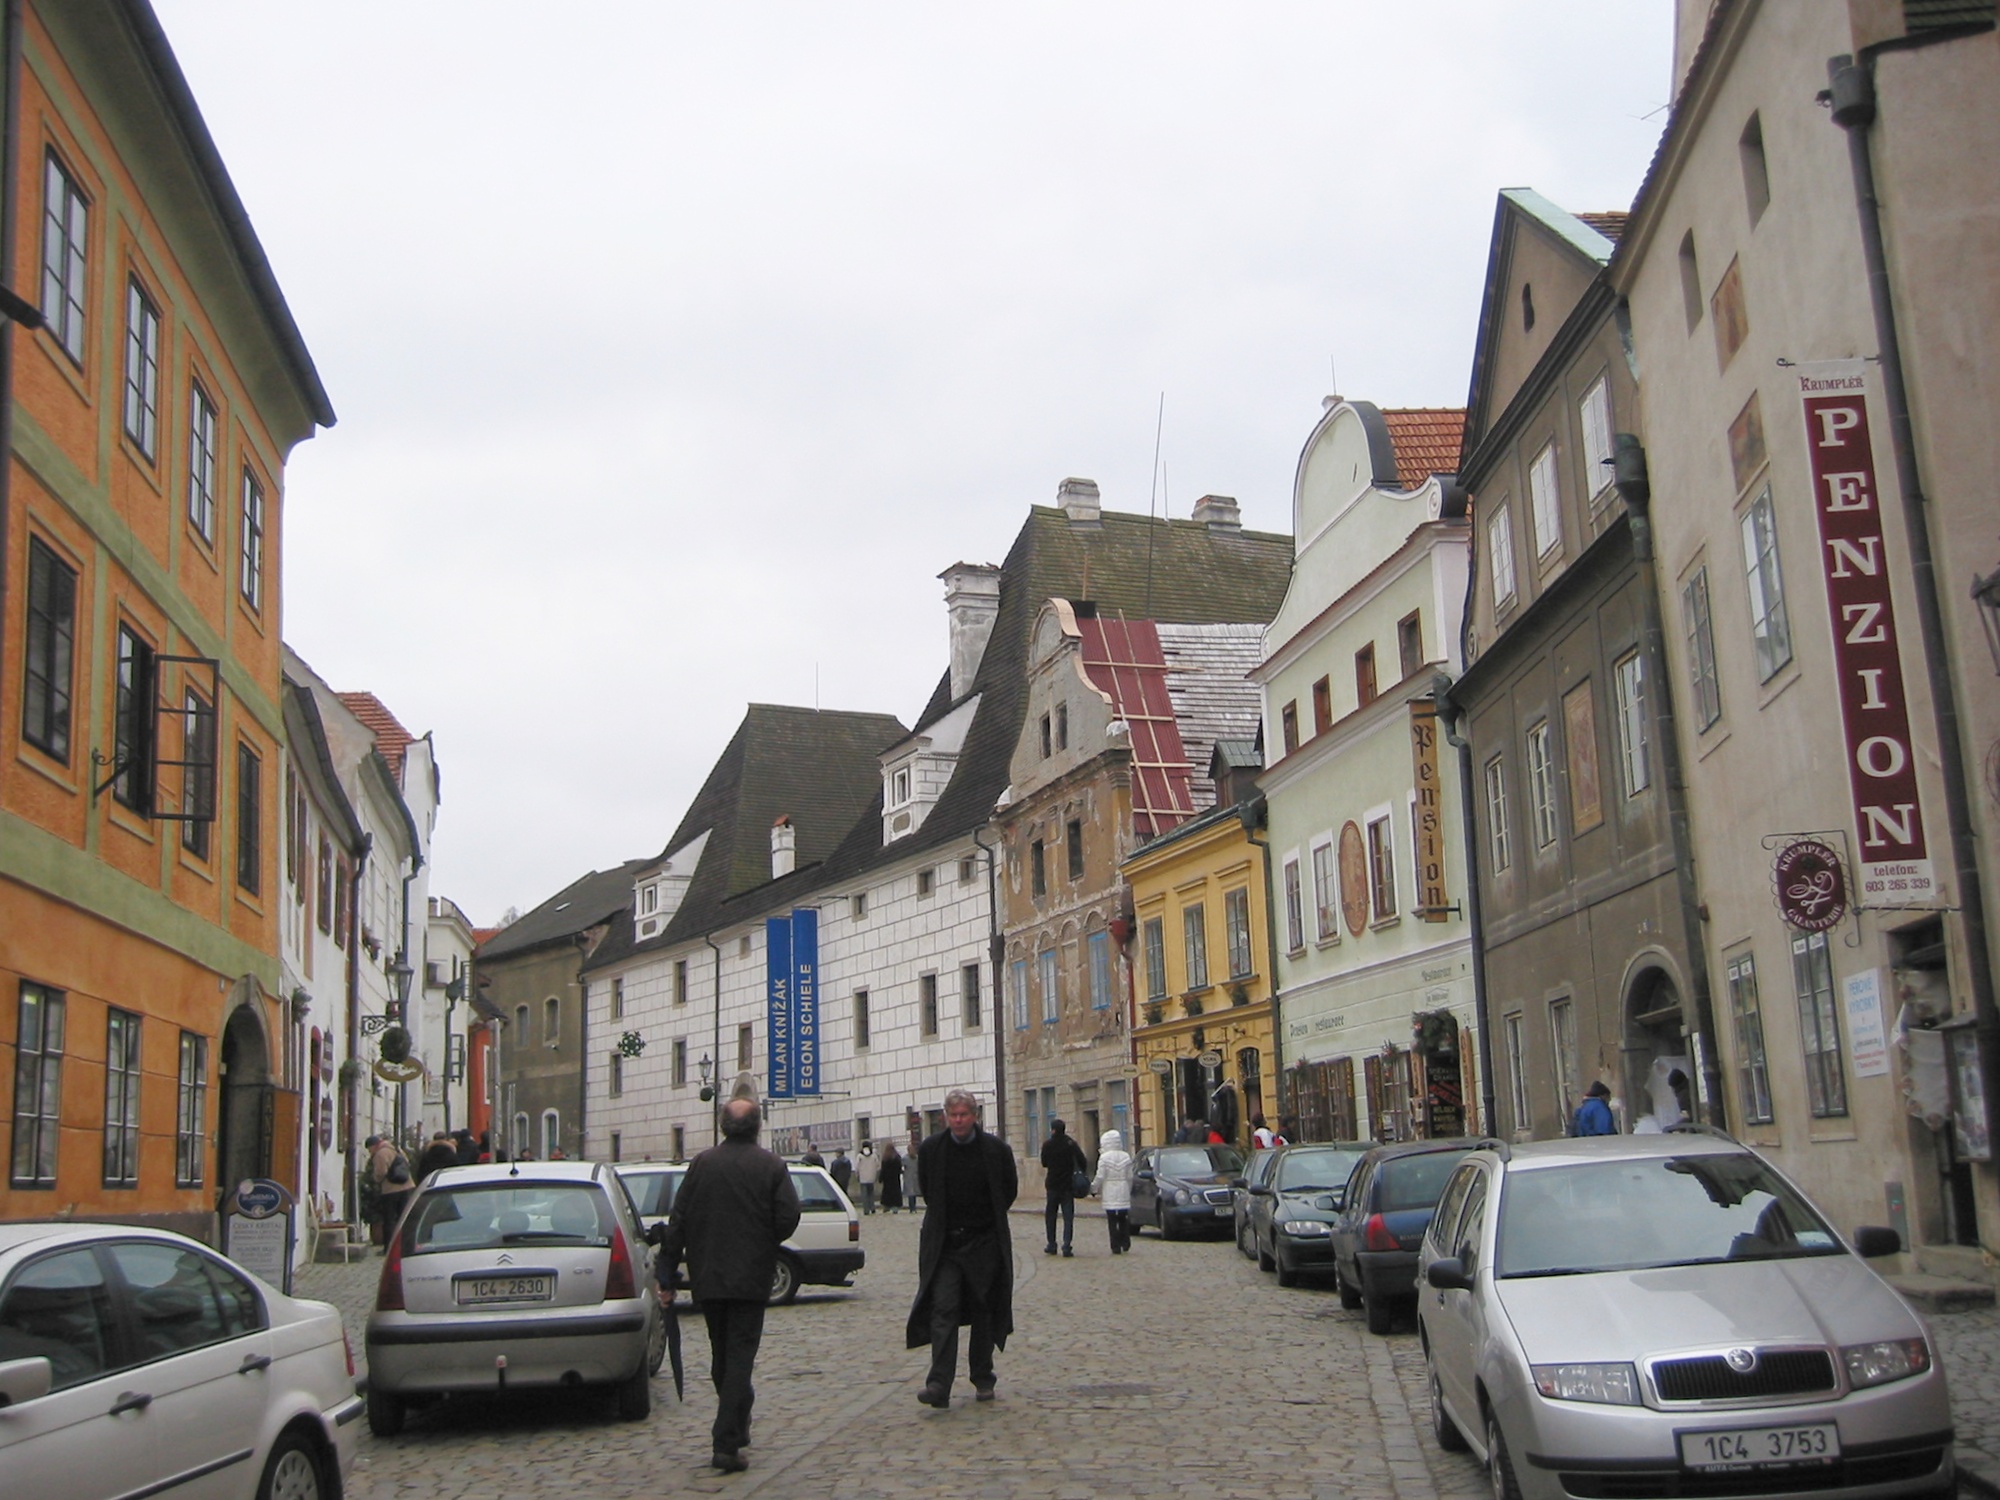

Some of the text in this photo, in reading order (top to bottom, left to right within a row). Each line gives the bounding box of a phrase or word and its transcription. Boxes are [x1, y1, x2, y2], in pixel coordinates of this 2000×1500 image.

[1800, 375, 1864, 392] KRUMPLER
[1814, 406, 1915, 848] PENZION
[1412, 724, 1441, 907] Pension
[1778, 844, 1837, 872] KRUMPLER
[1873, 863, 1918, 876] telefon:
[1865, 880, 1885, 892] 603
[1911, 877, 1931, 889] 339
[1786, 903, 1843, 928] GALANTERIE
[772, 978, 787, 1092] MILAN KNÍŽÁK
[800, 963, 813, 1088] EGON SCHIELE
[471, 1279, 544, 1297] 1C4 2630
[1704, 1429, 1827, 1460] 1C4 3753
